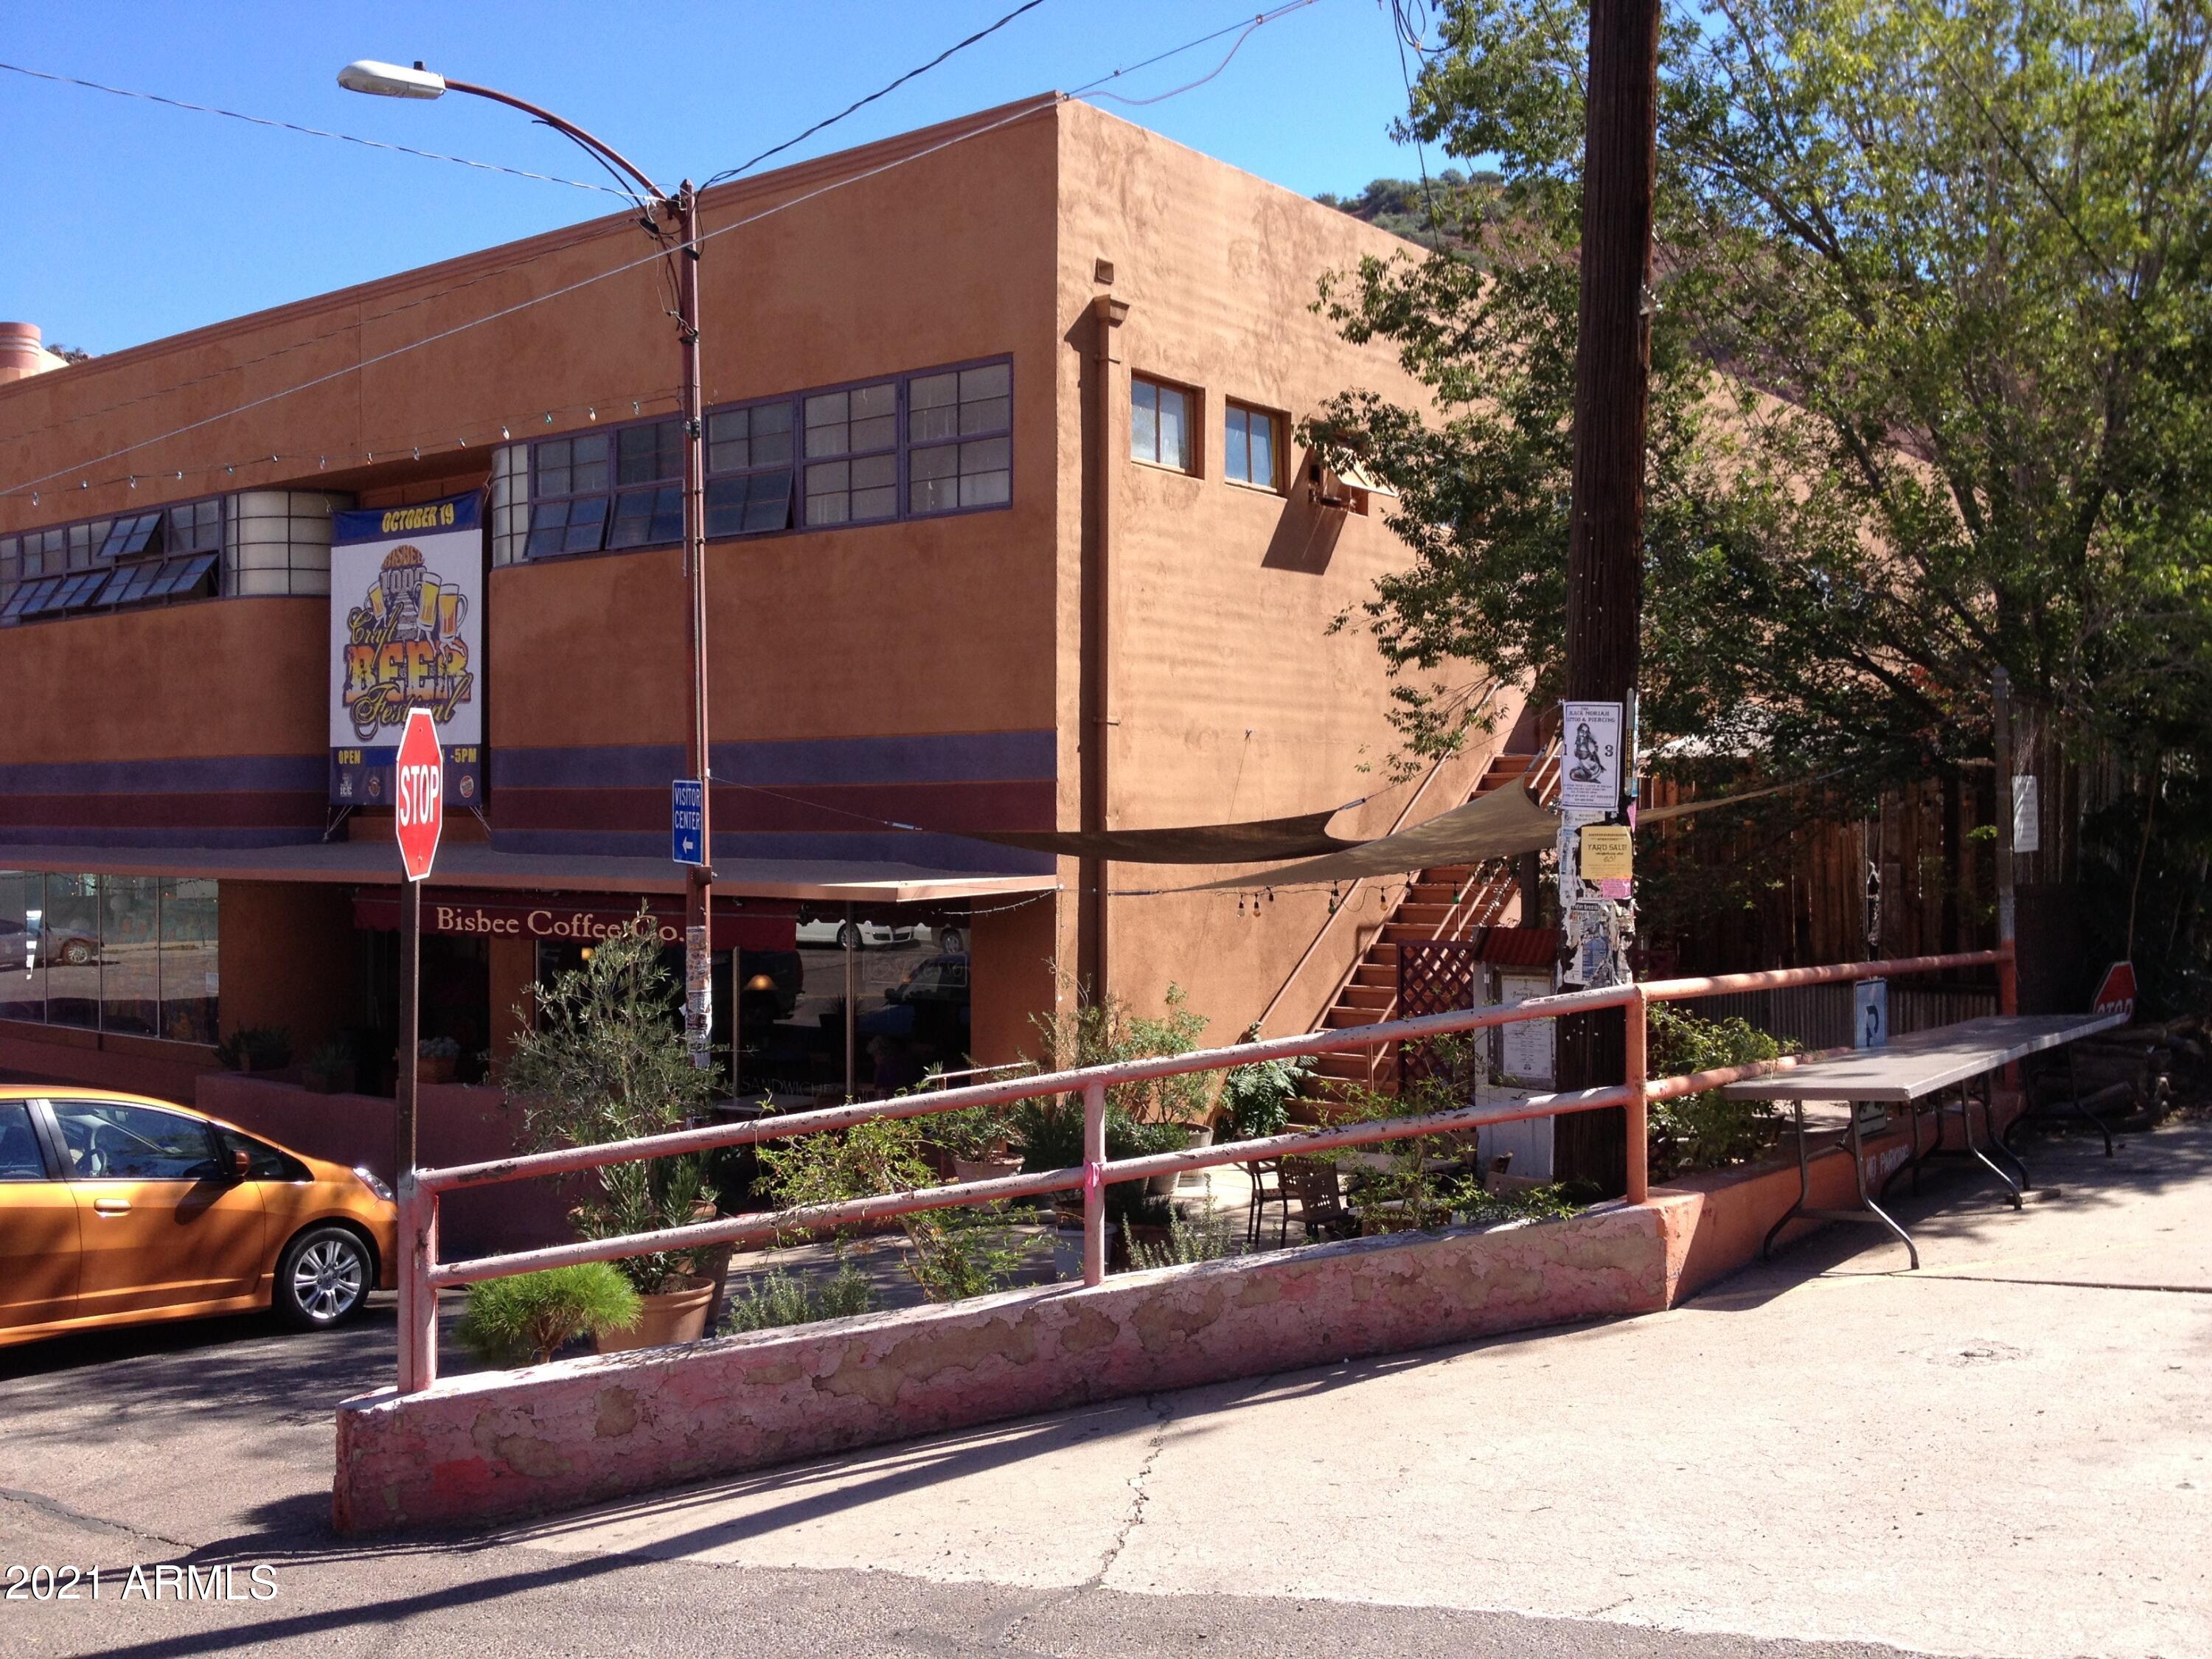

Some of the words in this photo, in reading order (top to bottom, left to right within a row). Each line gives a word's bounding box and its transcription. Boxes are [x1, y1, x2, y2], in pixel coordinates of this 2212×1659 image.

[382, 506, 437, 532] OCTOBER
[439, 503, 454, 525] 19
[343, 638, 473, 706] BEER
[351, 672, 474, 728] Festal
[338, 750, 361, 765] OPEN
[1604, 745, 1614, 757] 3
[400, 764, 439, 827] STOP
[675, 787, 700, 807] VISITOR
[675, 810, 700, 830] CENTER
[1587, 844, 1607, 852] YARD
[437, 906, 520, 933] Bisbee
[527, 910, 622, 939] Coffee
[630, 915, 685, 942] Co.
